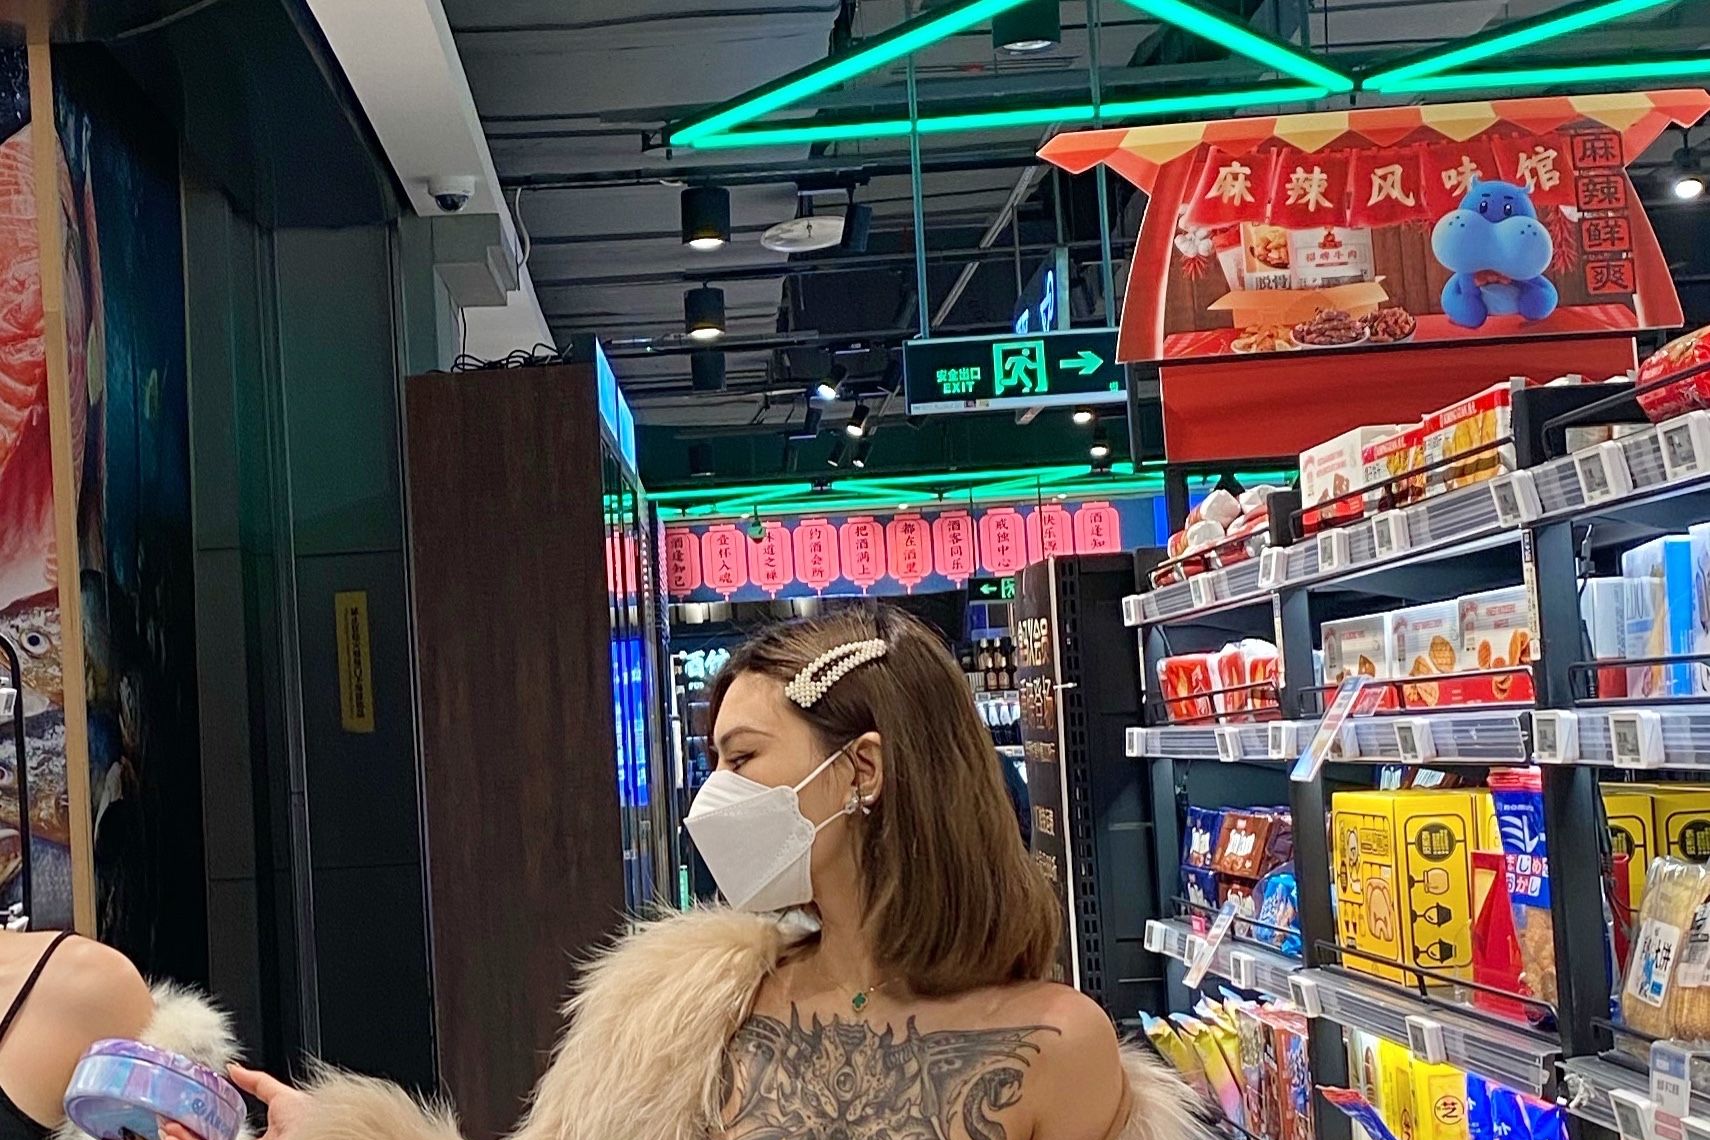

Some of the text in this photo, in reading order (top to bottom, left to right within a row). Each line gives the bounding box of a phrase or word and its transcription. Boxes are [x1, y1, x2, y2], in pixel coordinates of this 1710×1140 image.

[1204, 146, 1562, 212] 麻辣风味馆
[1580, 134, 1628, 291] 麻辣鲜爽
[936, 367, 981, 383] 安全出口
[943, 381, 976, 394] EXIT
[670, 534, 687, 588] 酒逢知己
